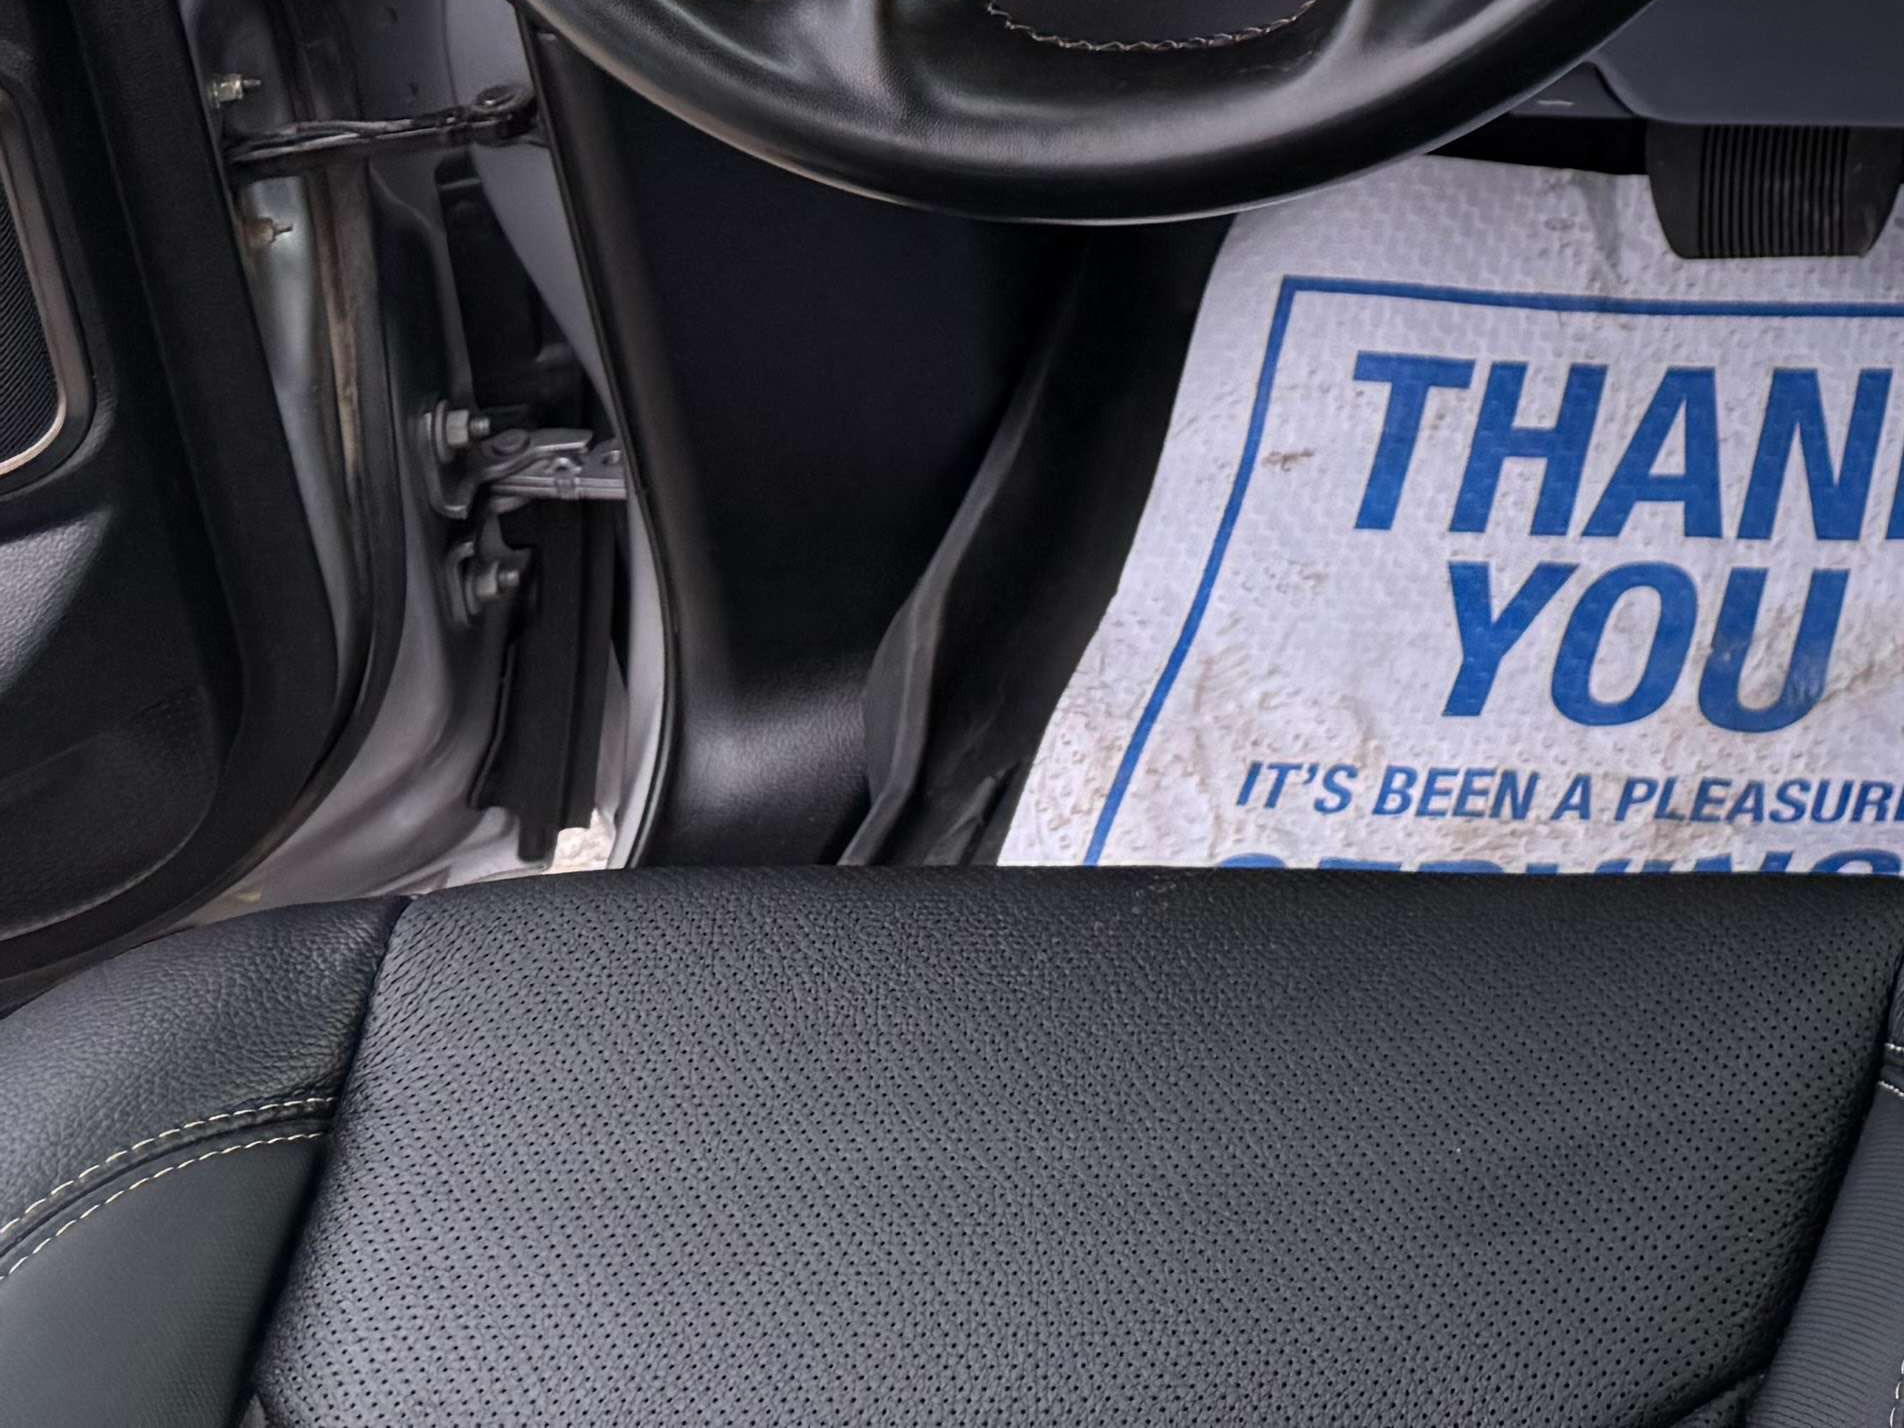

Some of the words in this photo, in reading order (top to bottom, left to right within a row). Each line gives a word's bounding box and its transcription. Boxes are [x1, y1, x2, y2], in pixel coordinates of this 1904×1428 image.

[1441, 557, 1852, 736] YOU
[1235, 760, 1358, 815] IT'S
[1372, 768, 1541, 822] BEEN
[1551, 775, 1593, 822] A
